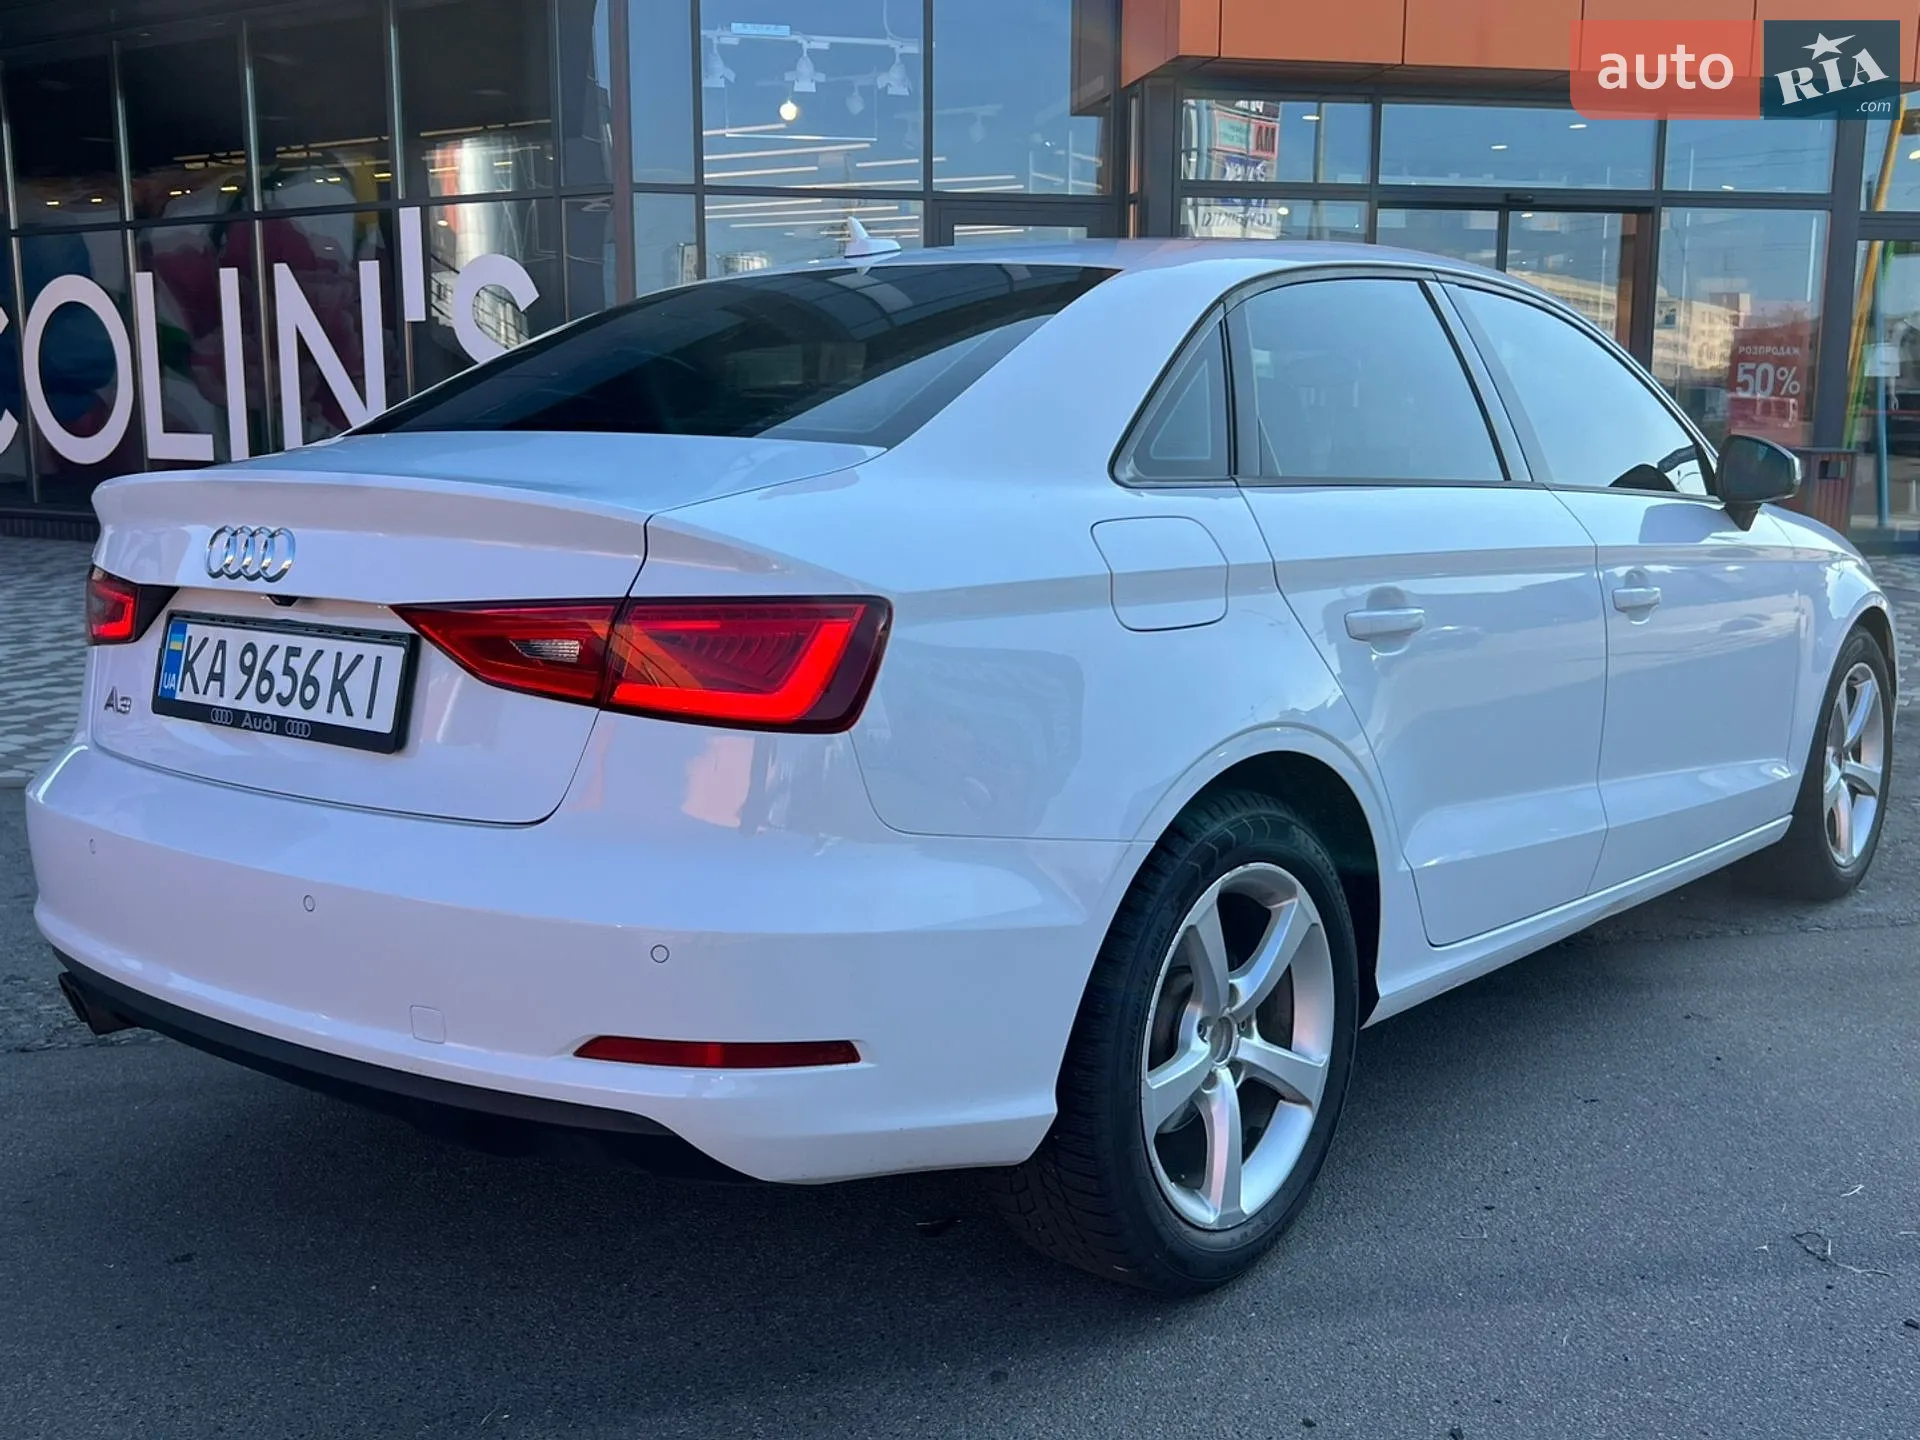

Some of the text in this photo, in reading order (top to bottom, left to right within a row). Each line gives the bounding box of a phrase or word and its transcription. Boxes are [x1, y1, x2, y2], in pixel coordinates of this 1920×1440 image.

[0, 207, 540, 465] OLIN'S
[1738, 345, 1800, 357] РОЗПРОДАЖ
[1735, 361, 1801, 399] 50%
[162, 671, 178, 691] UA
[103, 685, 132, 714] A3
[240, 714, 278, 734] Audi
